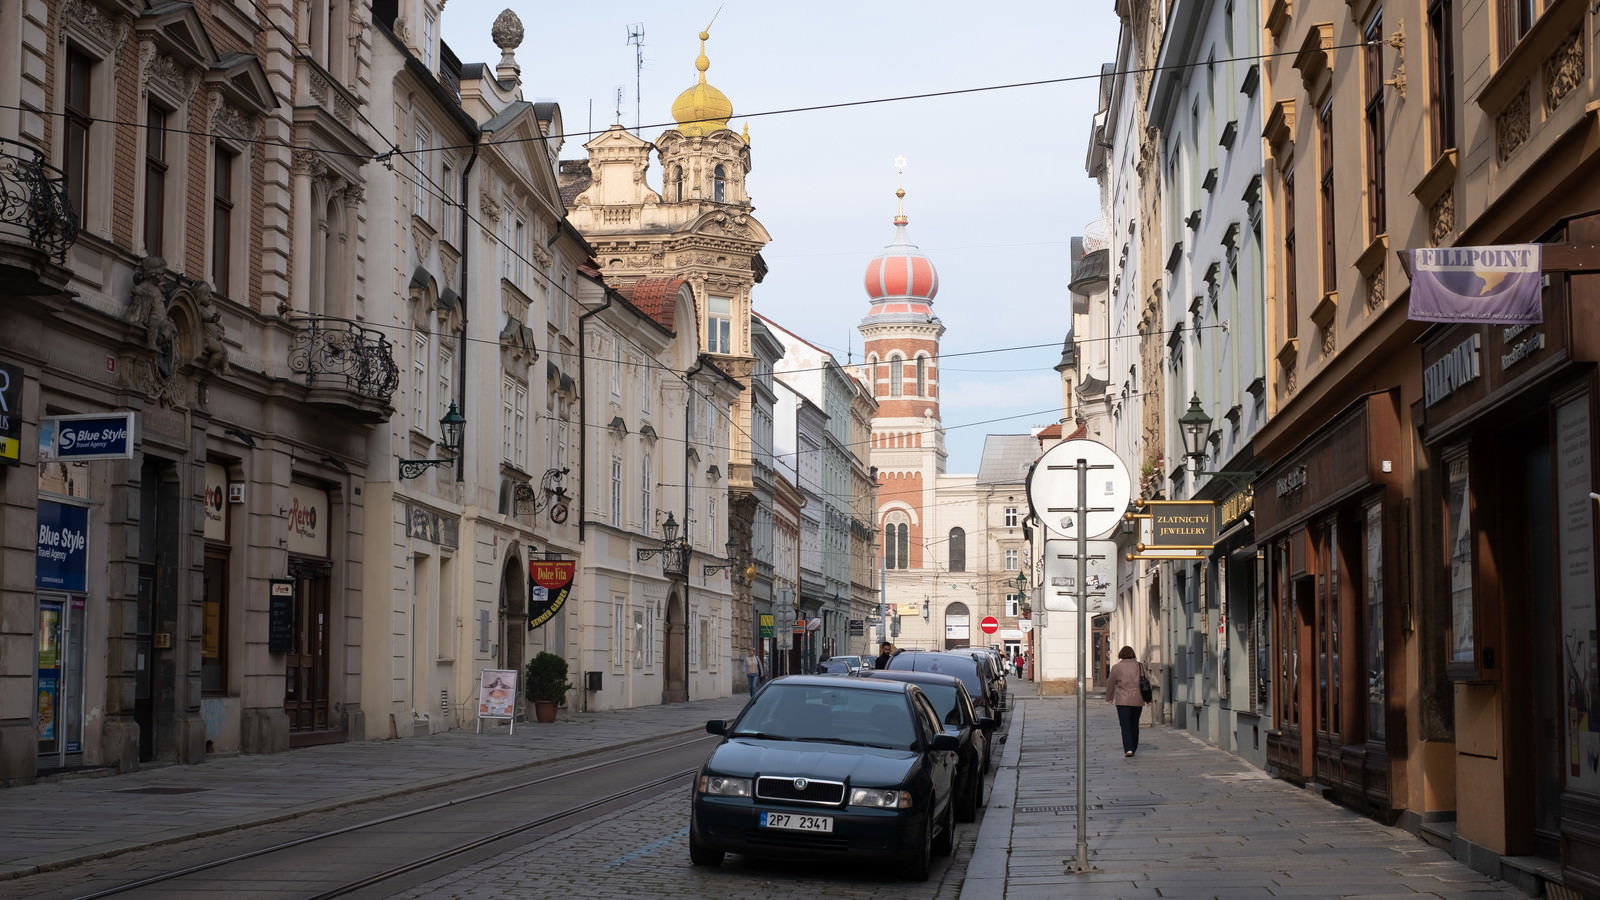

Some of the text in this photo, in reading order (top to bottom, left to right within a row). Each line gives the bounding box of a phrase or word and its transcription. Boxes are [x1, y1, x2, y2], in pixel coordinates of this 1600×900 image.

[1421, 249, 1532, 268] FILLPOINT
[1424, 333, 1481, 409] FILLPOINT
[76, 427, 128, 443] Blue Style
[90, 441, 107, 449] Agency
[1157, 514, 1209, 524] ZLATNICTVÍ
[39, 524, 85, 553] Blue Style
[1160, 527, 1207, 537] JEWELLERY
[38, 546, 67, 562] Travel Agency
[537, 567, 567, 580] Dolce Vita
[769, 814, 791, 827] 2P7
[799, 816, 828, 830] 2341
